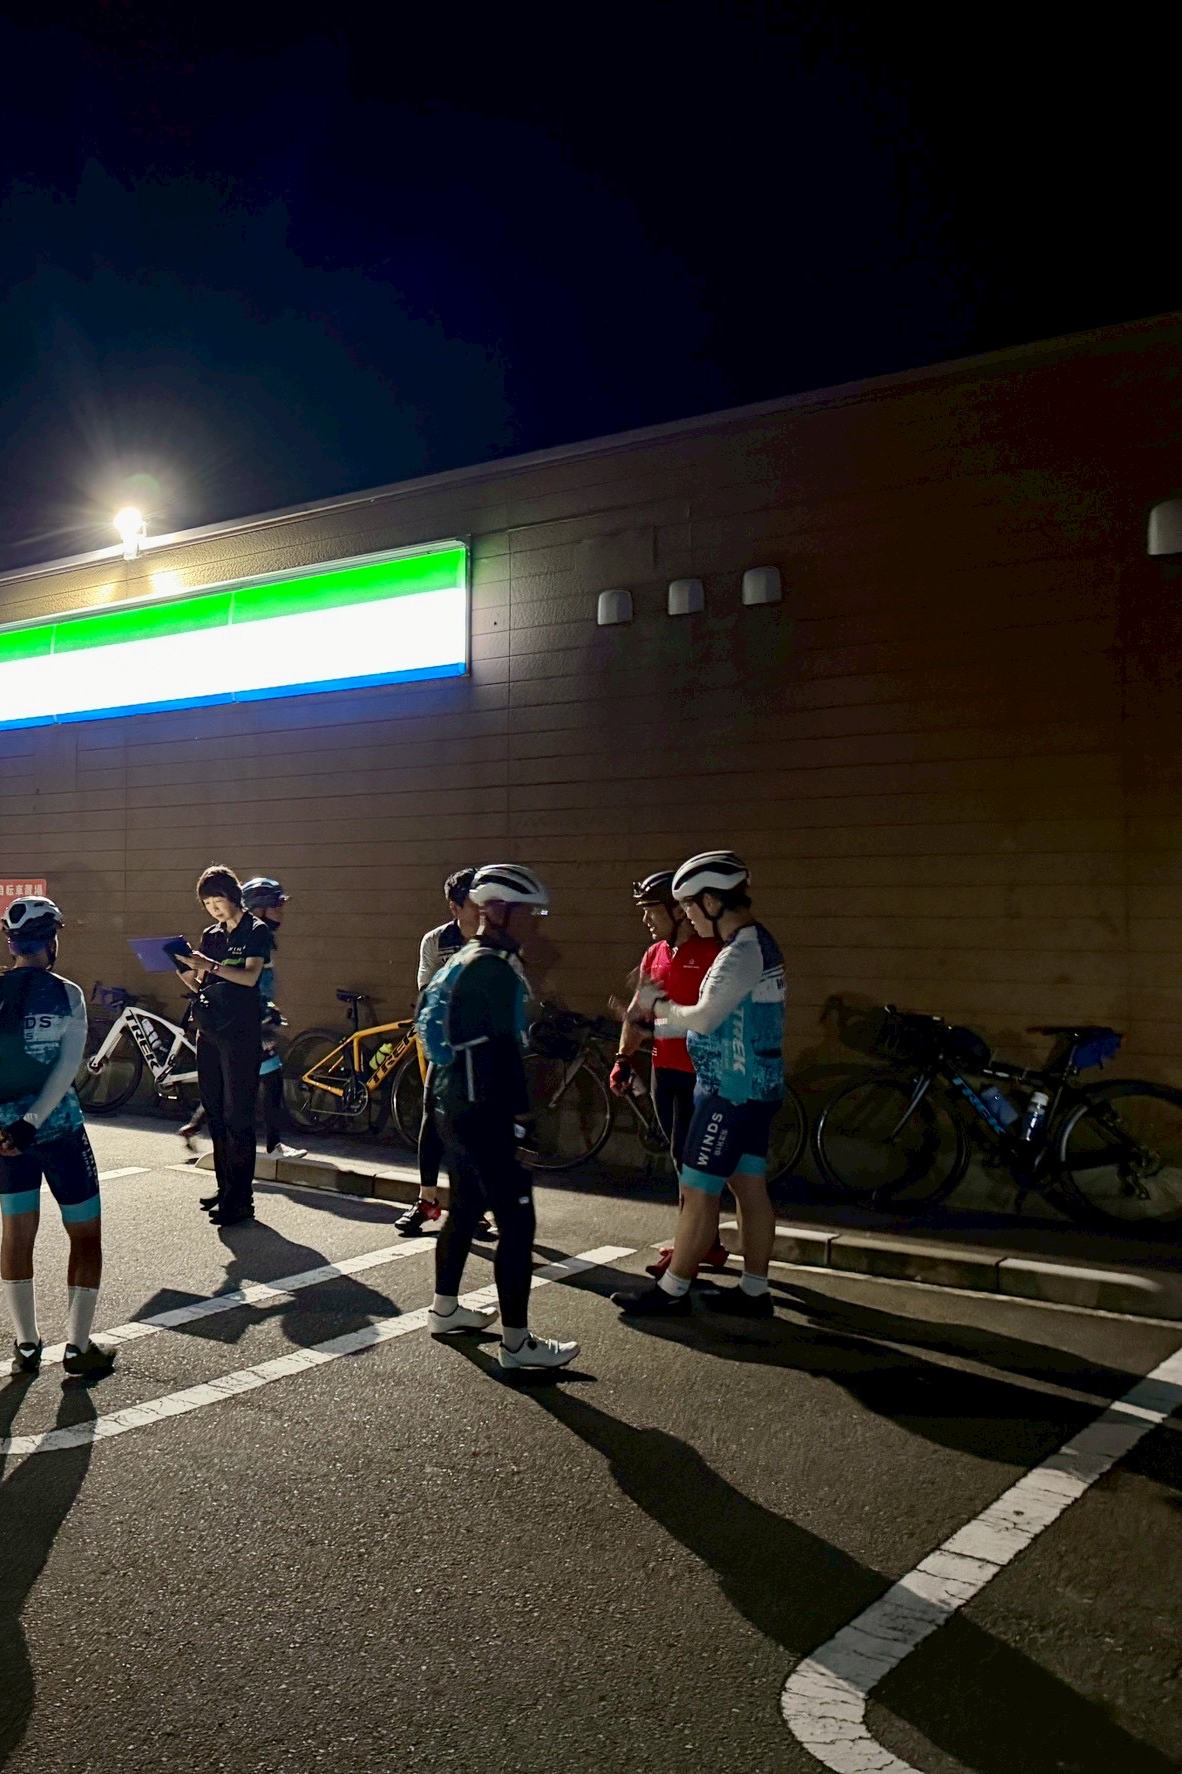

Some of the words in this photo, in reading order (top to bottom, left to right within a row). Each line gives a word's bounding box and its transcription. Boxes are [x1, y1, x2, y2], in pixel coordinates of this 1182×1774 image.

[126, 1009, 160, 1070] TREK
[367, 1026, 418, 1084] TREK
[732, 1007, 746, 1076] TREK
[697, 1112, 723, 1166] WINDS
